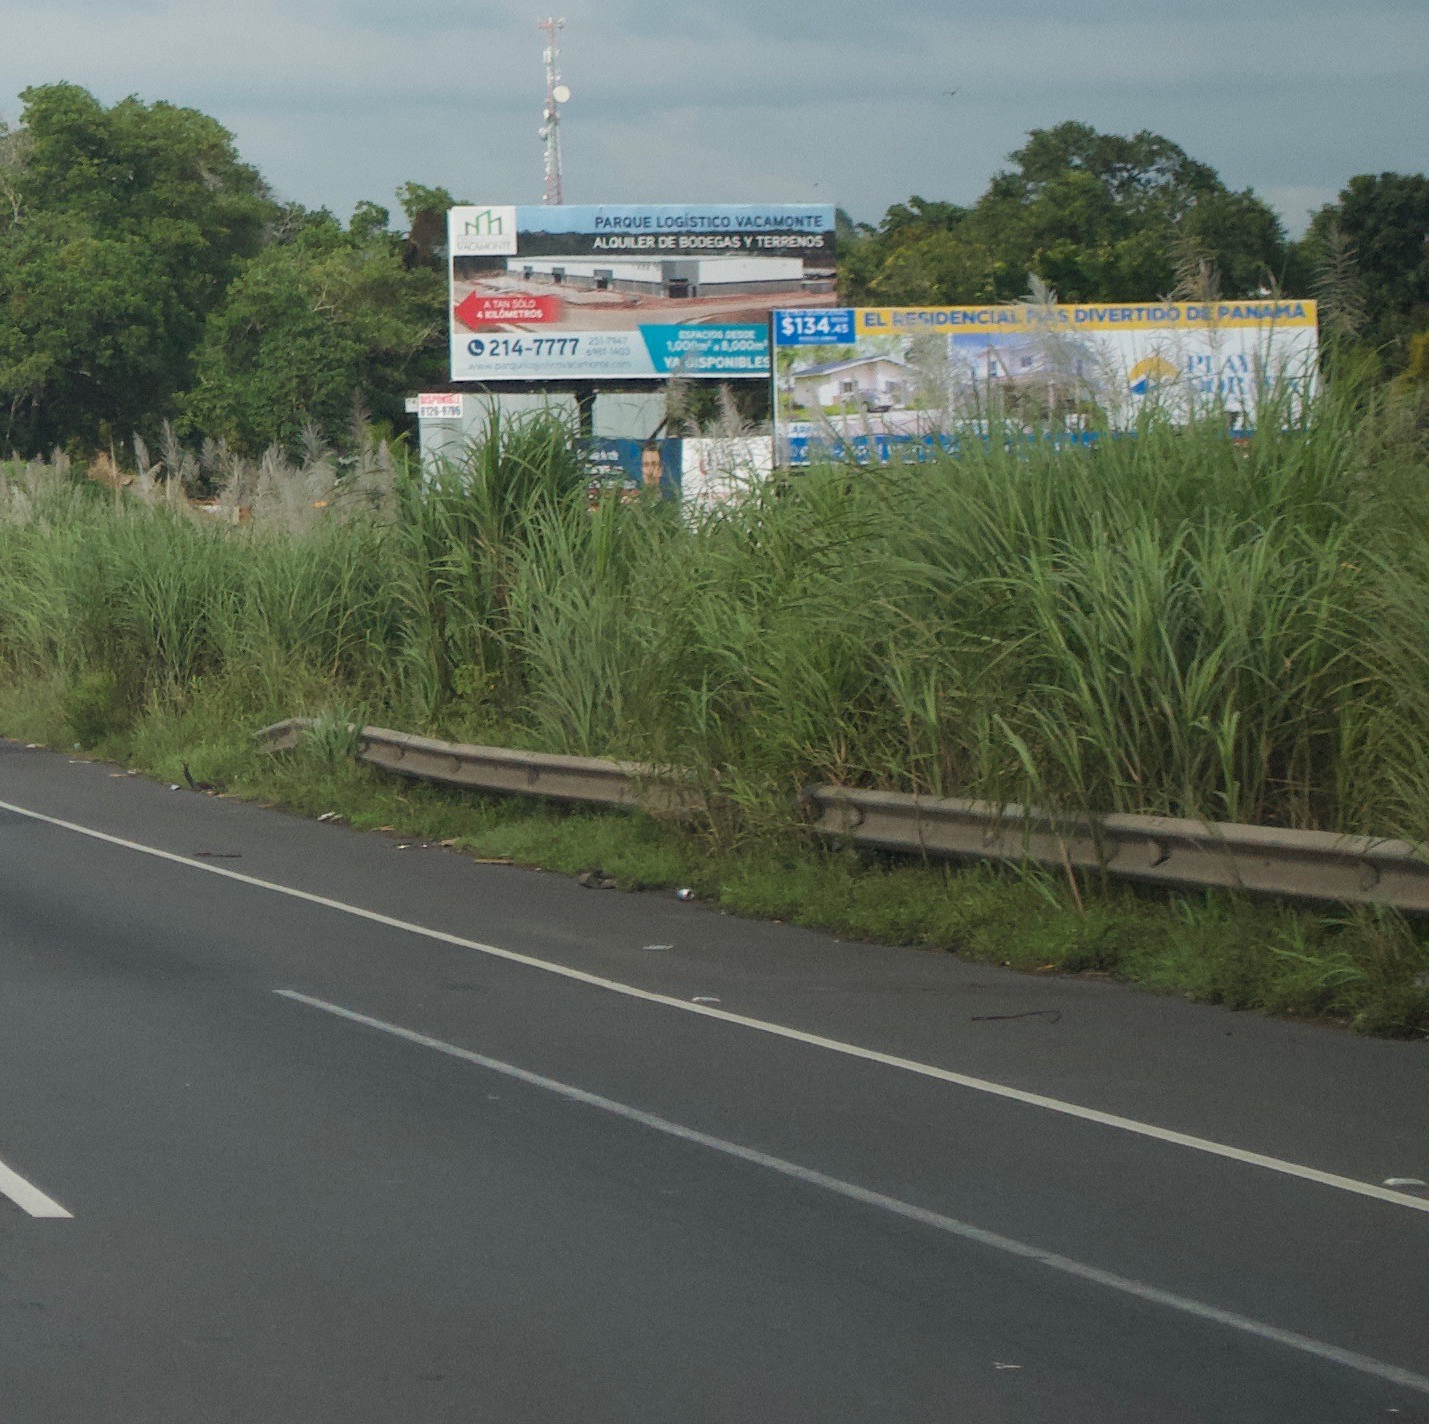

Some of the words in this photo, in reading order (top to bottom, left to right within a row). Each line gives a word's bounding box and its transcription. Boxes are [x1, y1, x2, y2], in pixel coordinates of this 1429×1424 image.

[595, 216, 651, 228] PARQUE
[656, 212, 730, 228] LOGÍSTICO
[735, 215, 823, 227] VACAMONTE
[593, 236, 656, 249] ALQUILER
[658, 236, 677, 248] DE
[679, 236, 742, 248] BODEGAS
[743, 236, 753, 248] Y
[755, 235, 825, 248] TERRENOS
[864, 312, 887, 326] EL
[892, 310, 1017, 326] RESIDENCIAL
[1074, 306, 1182, 323] DIVERTIDO
[1186, 306, 1213, 321] DE
[488, 338, 580, 356] 214-7777
[664, 356, 681, 368] YA
[684, 356, 770, 369] DISPONIBLES
